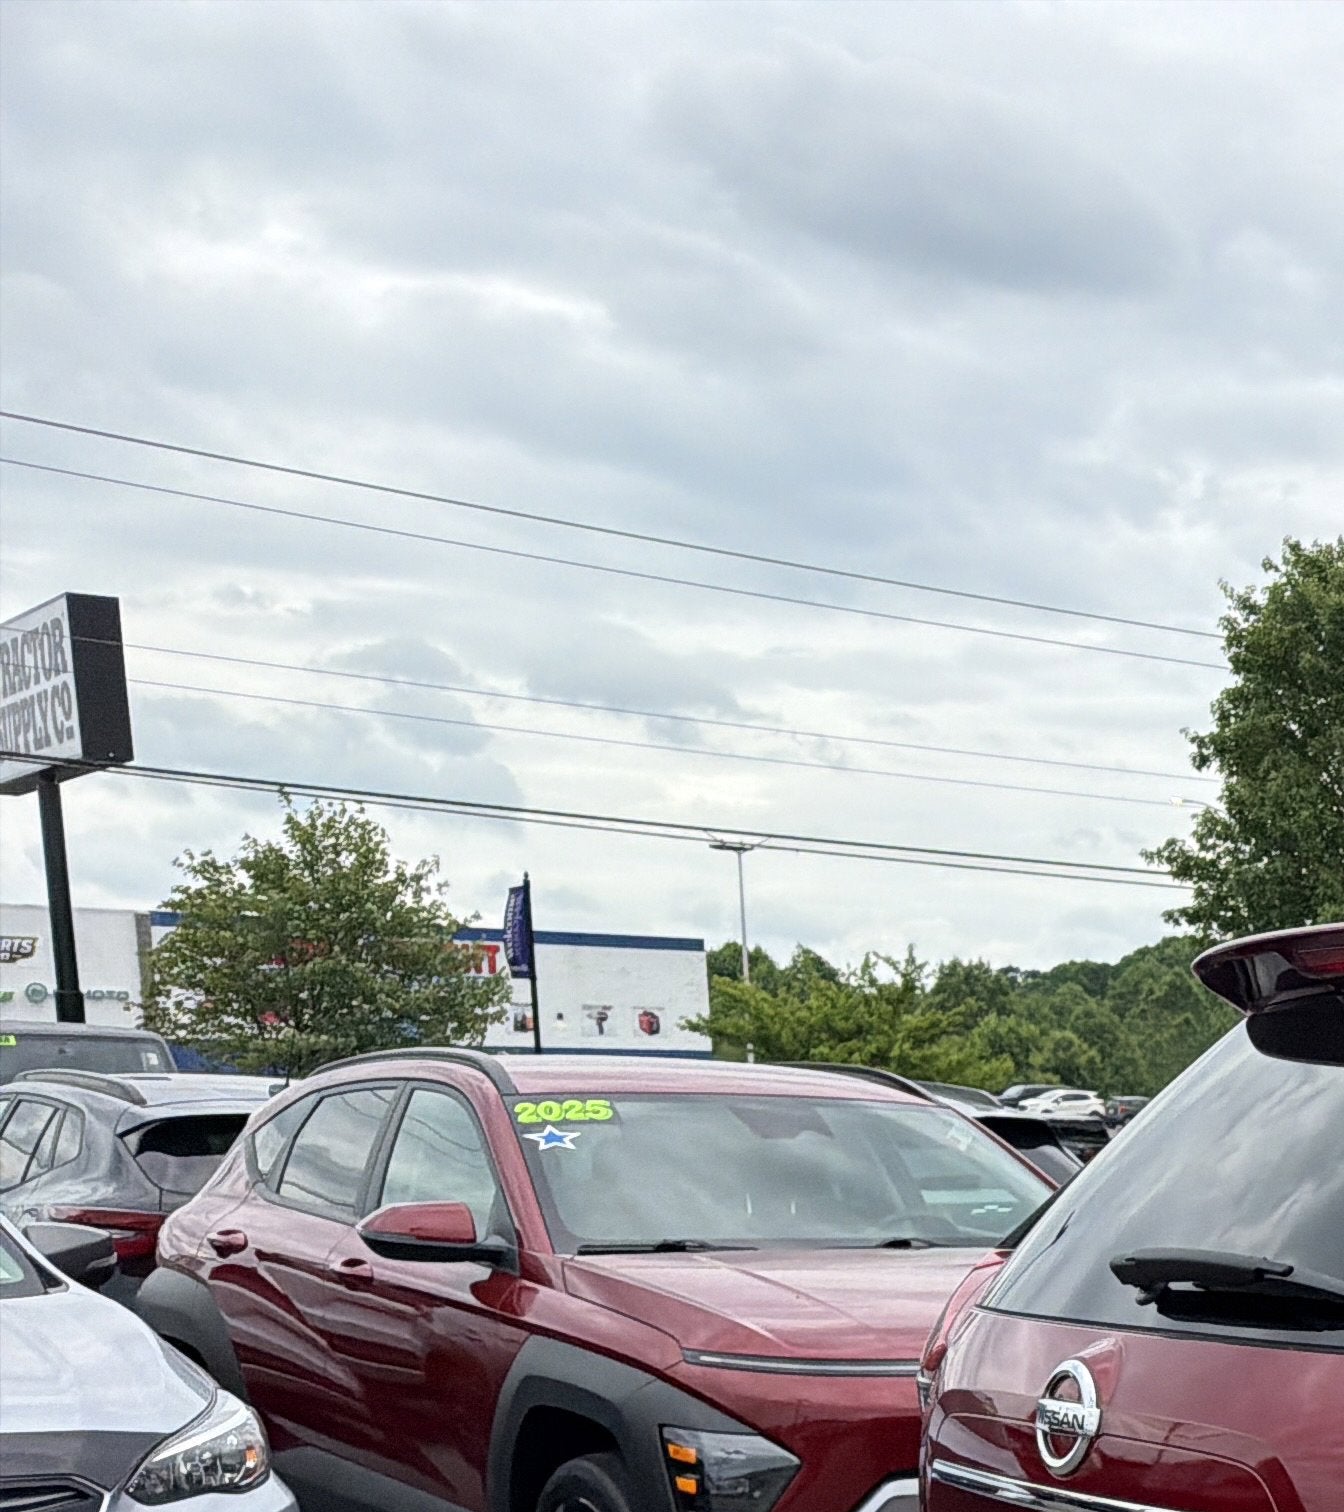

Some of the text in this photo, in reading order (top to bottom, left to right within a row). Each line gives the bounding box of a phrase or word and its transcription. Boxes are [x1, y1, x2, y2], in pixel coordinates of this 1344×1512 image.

[0, 617, 68, 698] RACTOR
[0, 687, 51, 754] UPPLY
[514, 1100, 613, 1123] 2025
